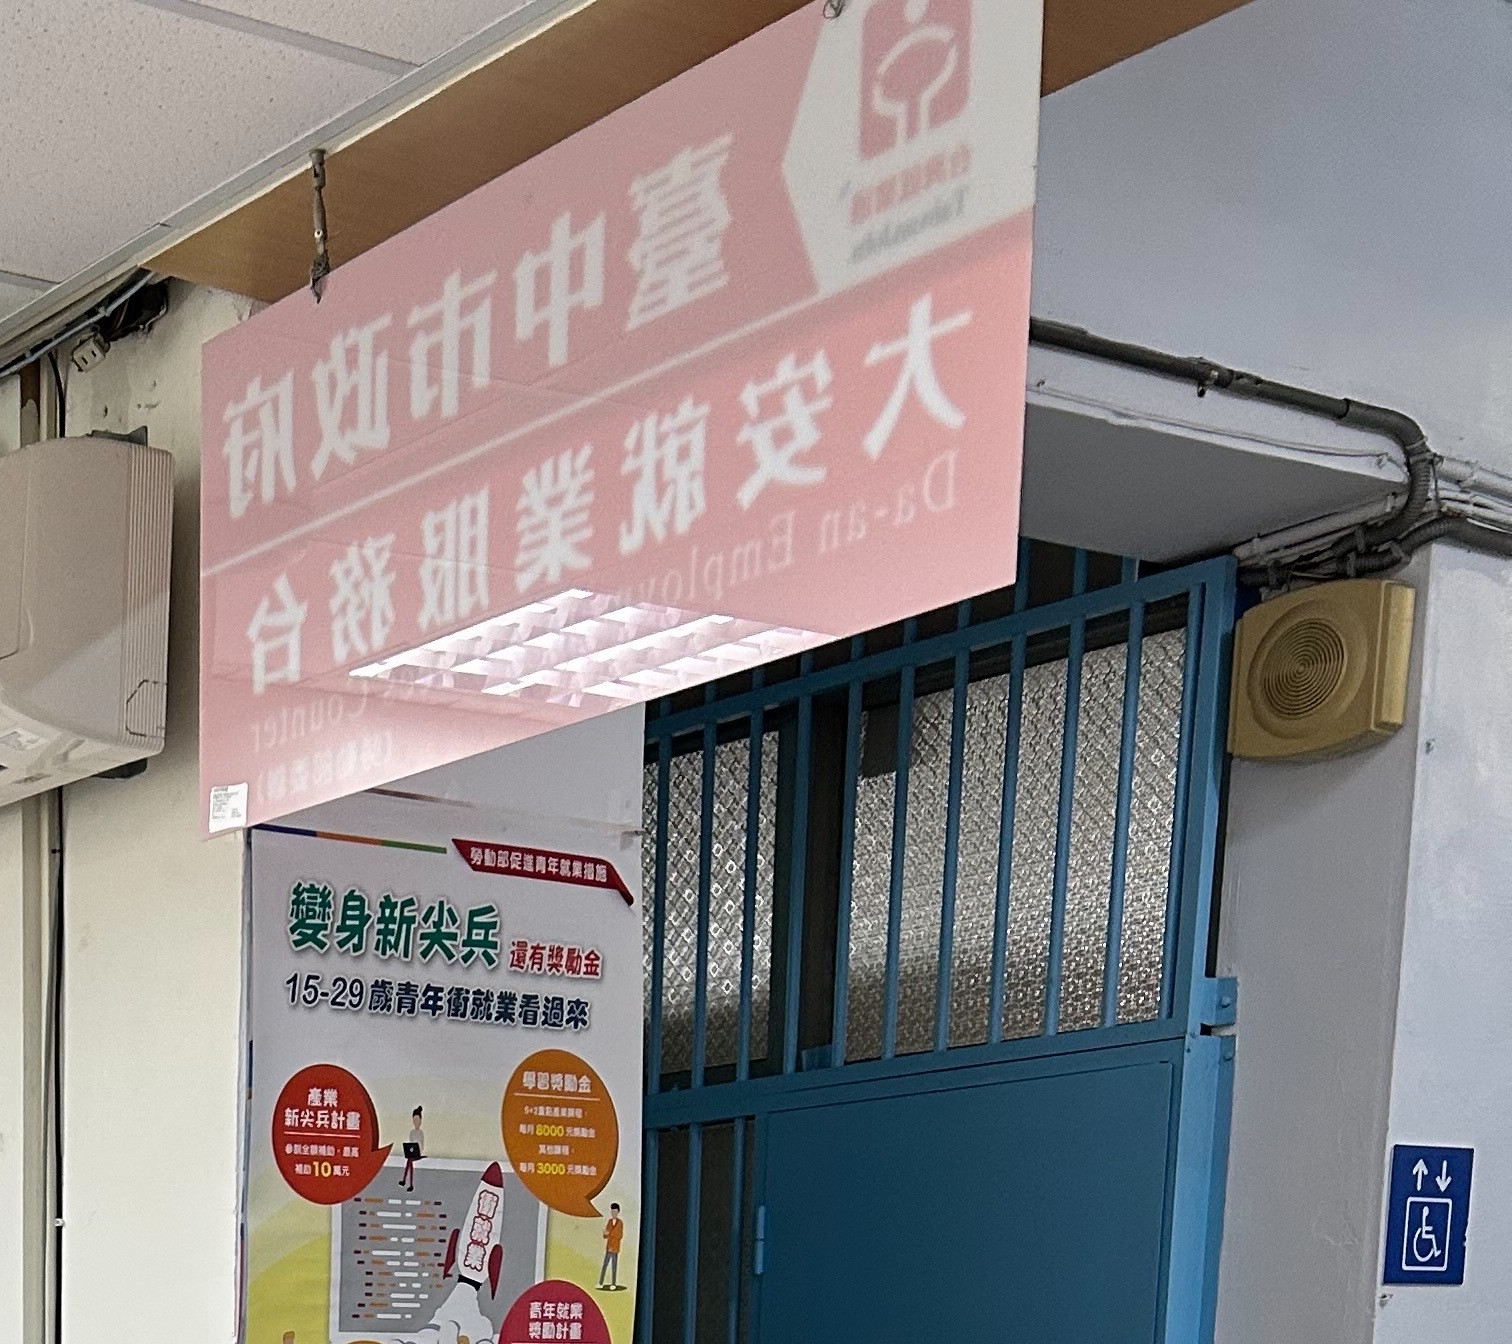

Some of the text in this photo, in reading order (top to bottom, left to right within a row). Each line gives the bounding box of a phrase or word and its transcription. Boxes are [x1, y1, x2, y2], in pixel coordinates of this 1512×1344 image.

[288, 881, 602, 977] 變身新尖兵 還有獎勵金
[308, 1087, 338, 1107] 產業
[284, 1107, 361, 1130] 新尖兵計畫
